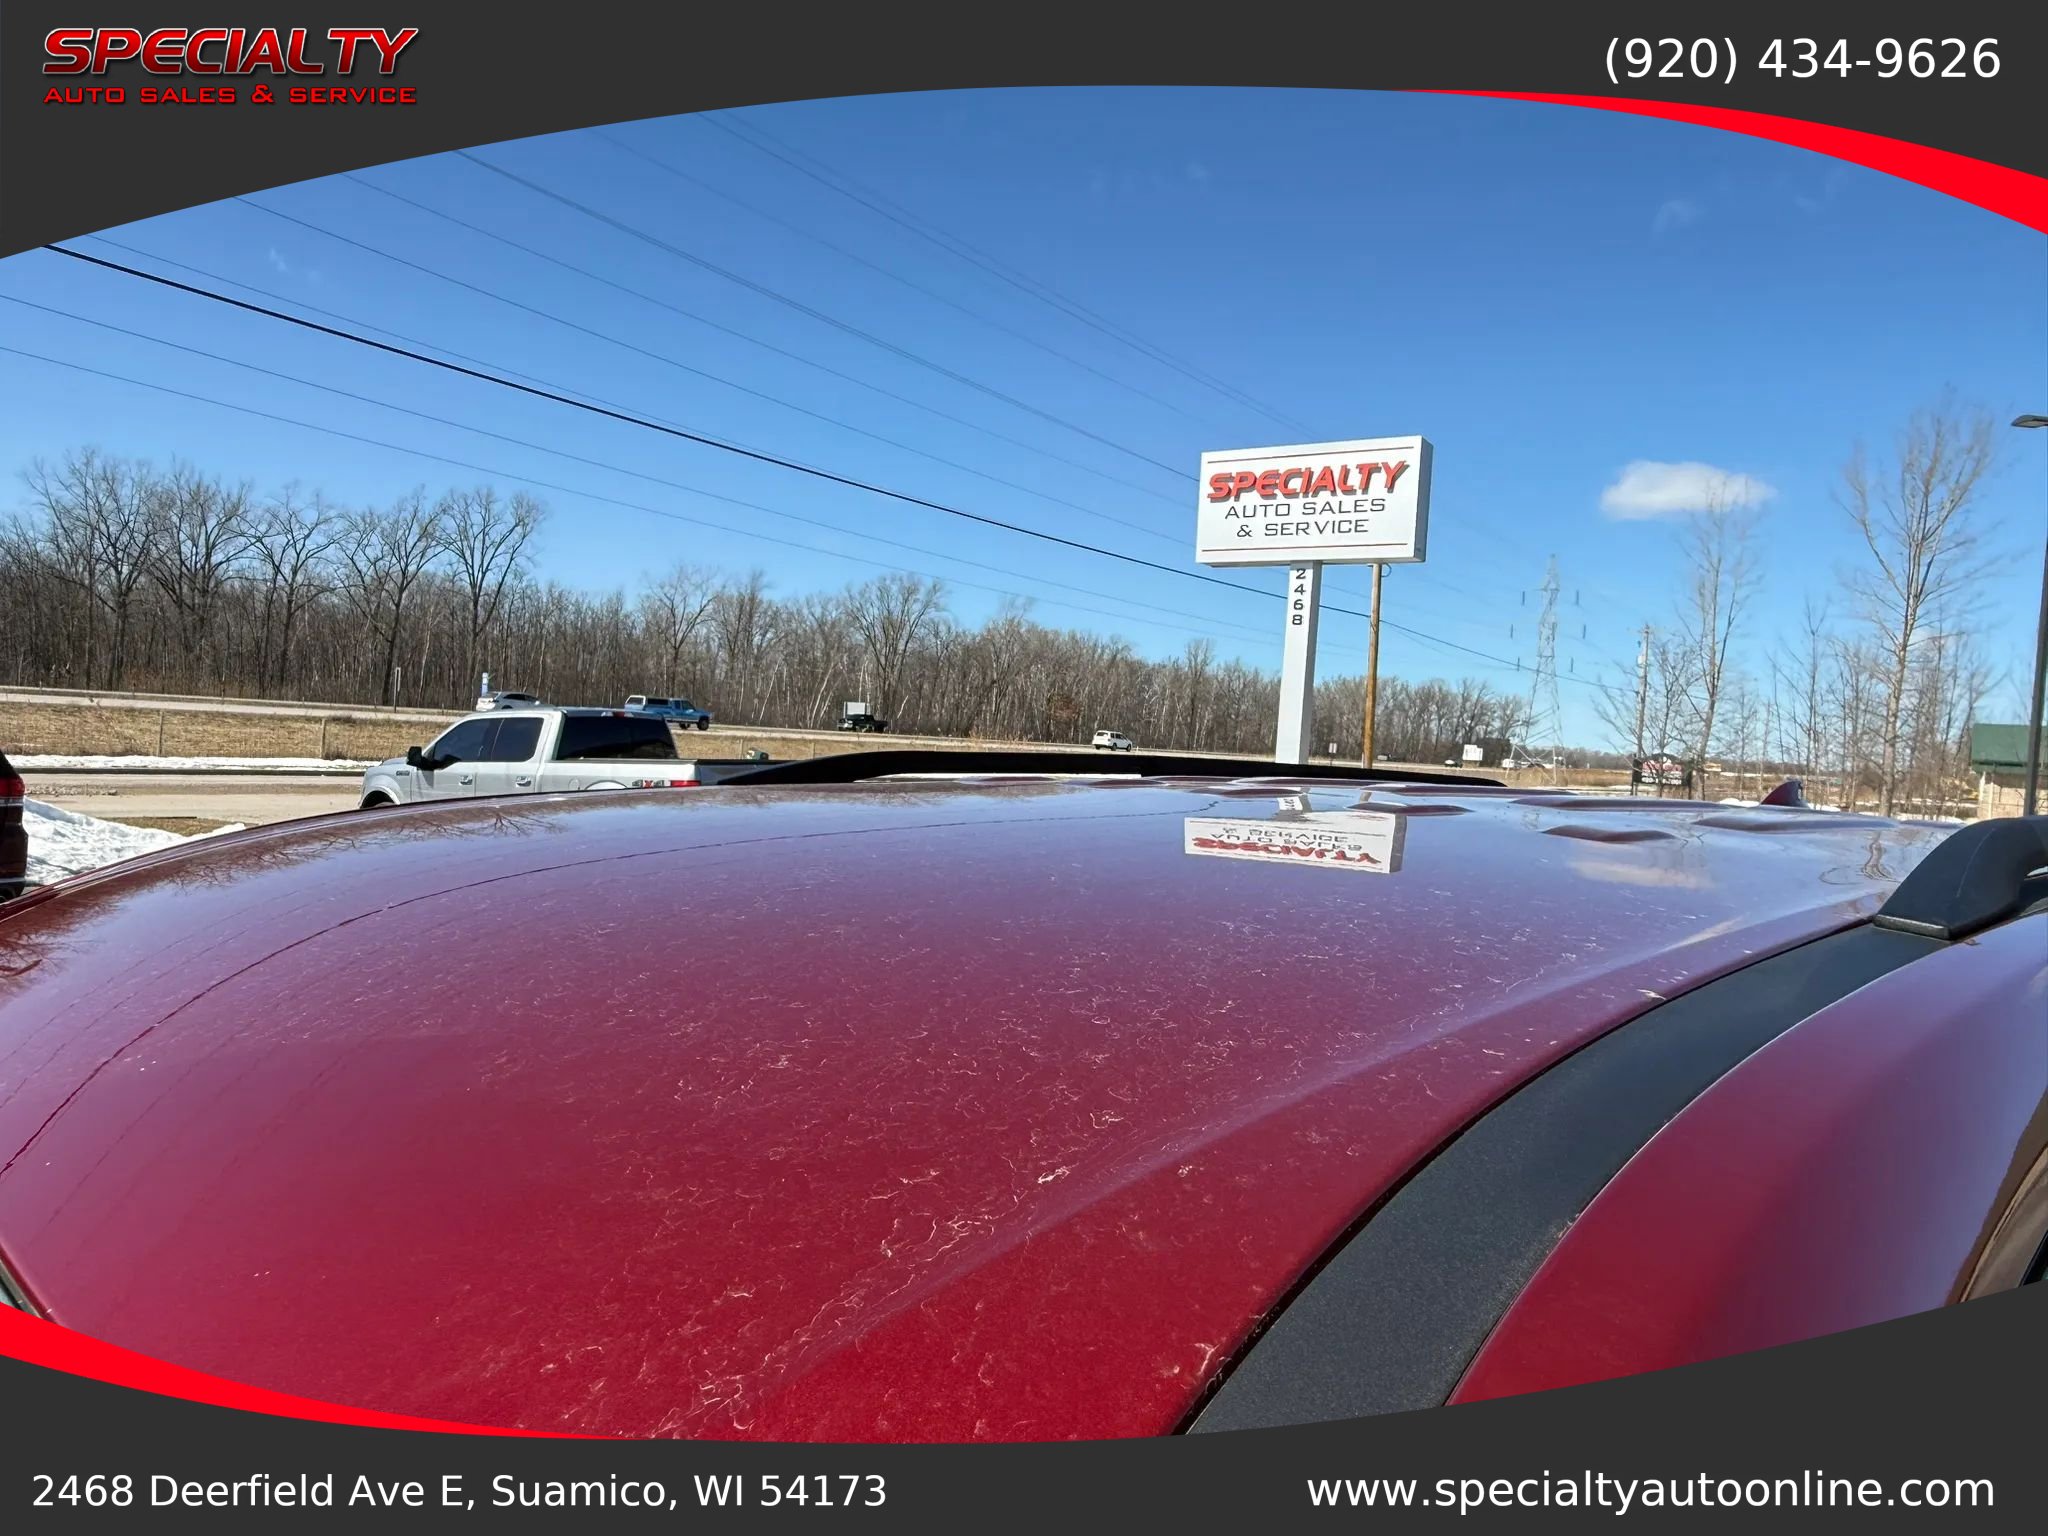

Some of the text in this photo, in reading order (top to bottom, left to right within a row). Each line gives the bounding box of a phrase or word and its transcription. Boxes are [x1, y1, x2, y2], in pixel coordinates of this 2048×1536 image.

[1207, 460, 1410, 503] SPECIALTY
[1225, 498, 1386, 519] AUTO SALES
[1237, 519, 1369, 537] & SERVICE
[1291, 568, 1307, 626] 2468
